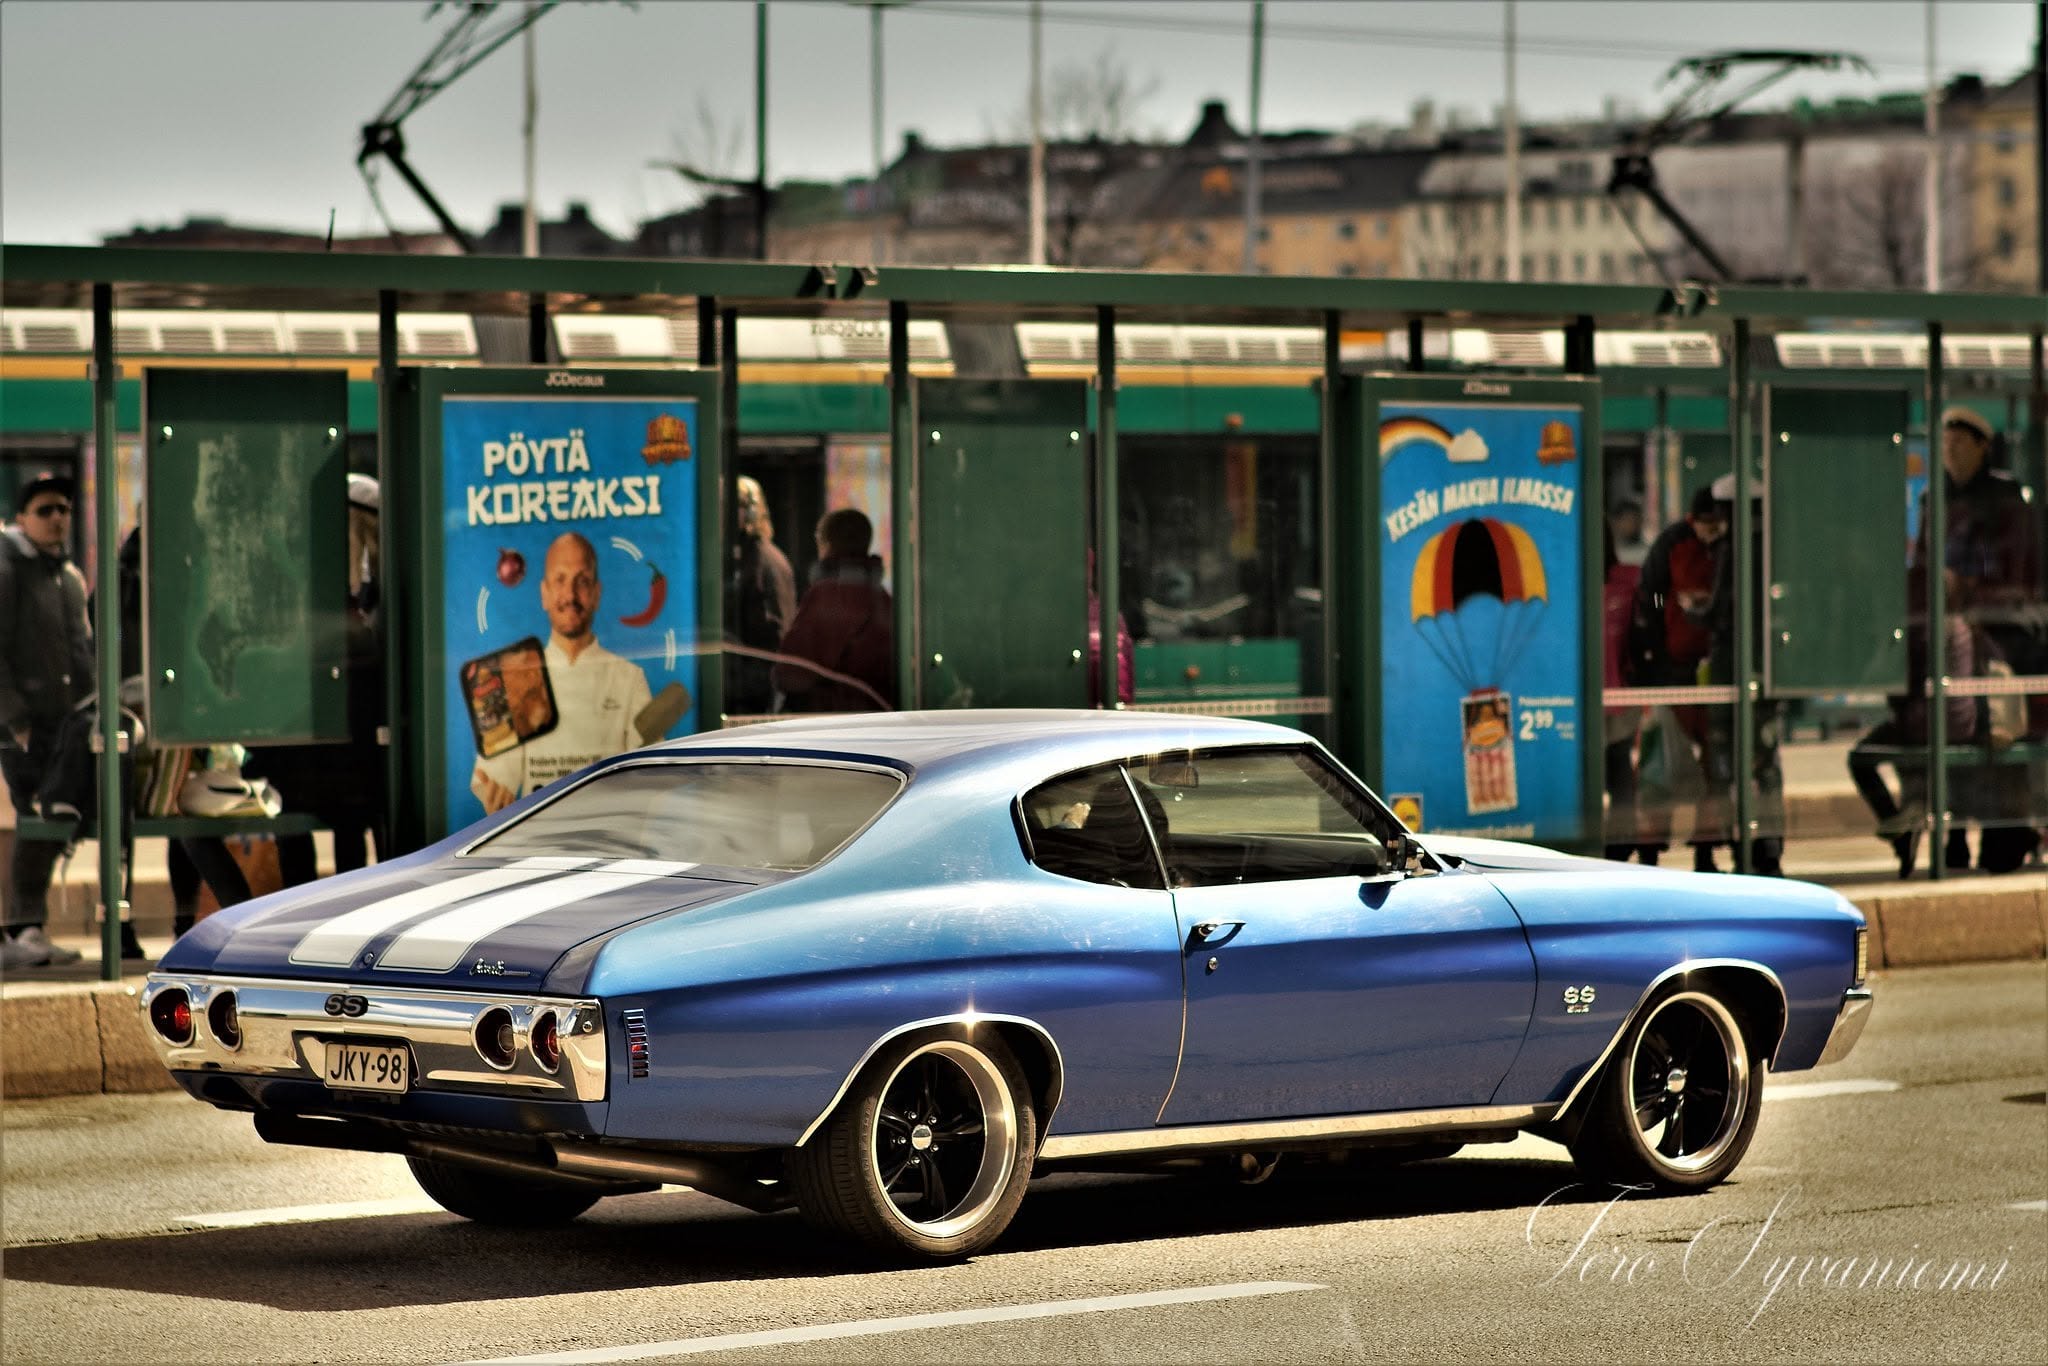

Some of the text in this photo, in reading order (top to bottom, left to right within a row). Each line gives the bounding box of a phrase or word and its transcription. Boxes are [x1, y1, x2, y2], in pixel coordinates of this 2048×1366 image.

[483, 428, 591, 477] PÖYTÄ
[467, 475, 662, 526] KOREAKSI
[1386, 478, 1574, 543] KESÄN MAKUA ILMASSA
[325, 994, 368, 1017] SS
[1563, 985, 1596, 1004] SS
[330, 1050, 402, 1084] JKY-98
